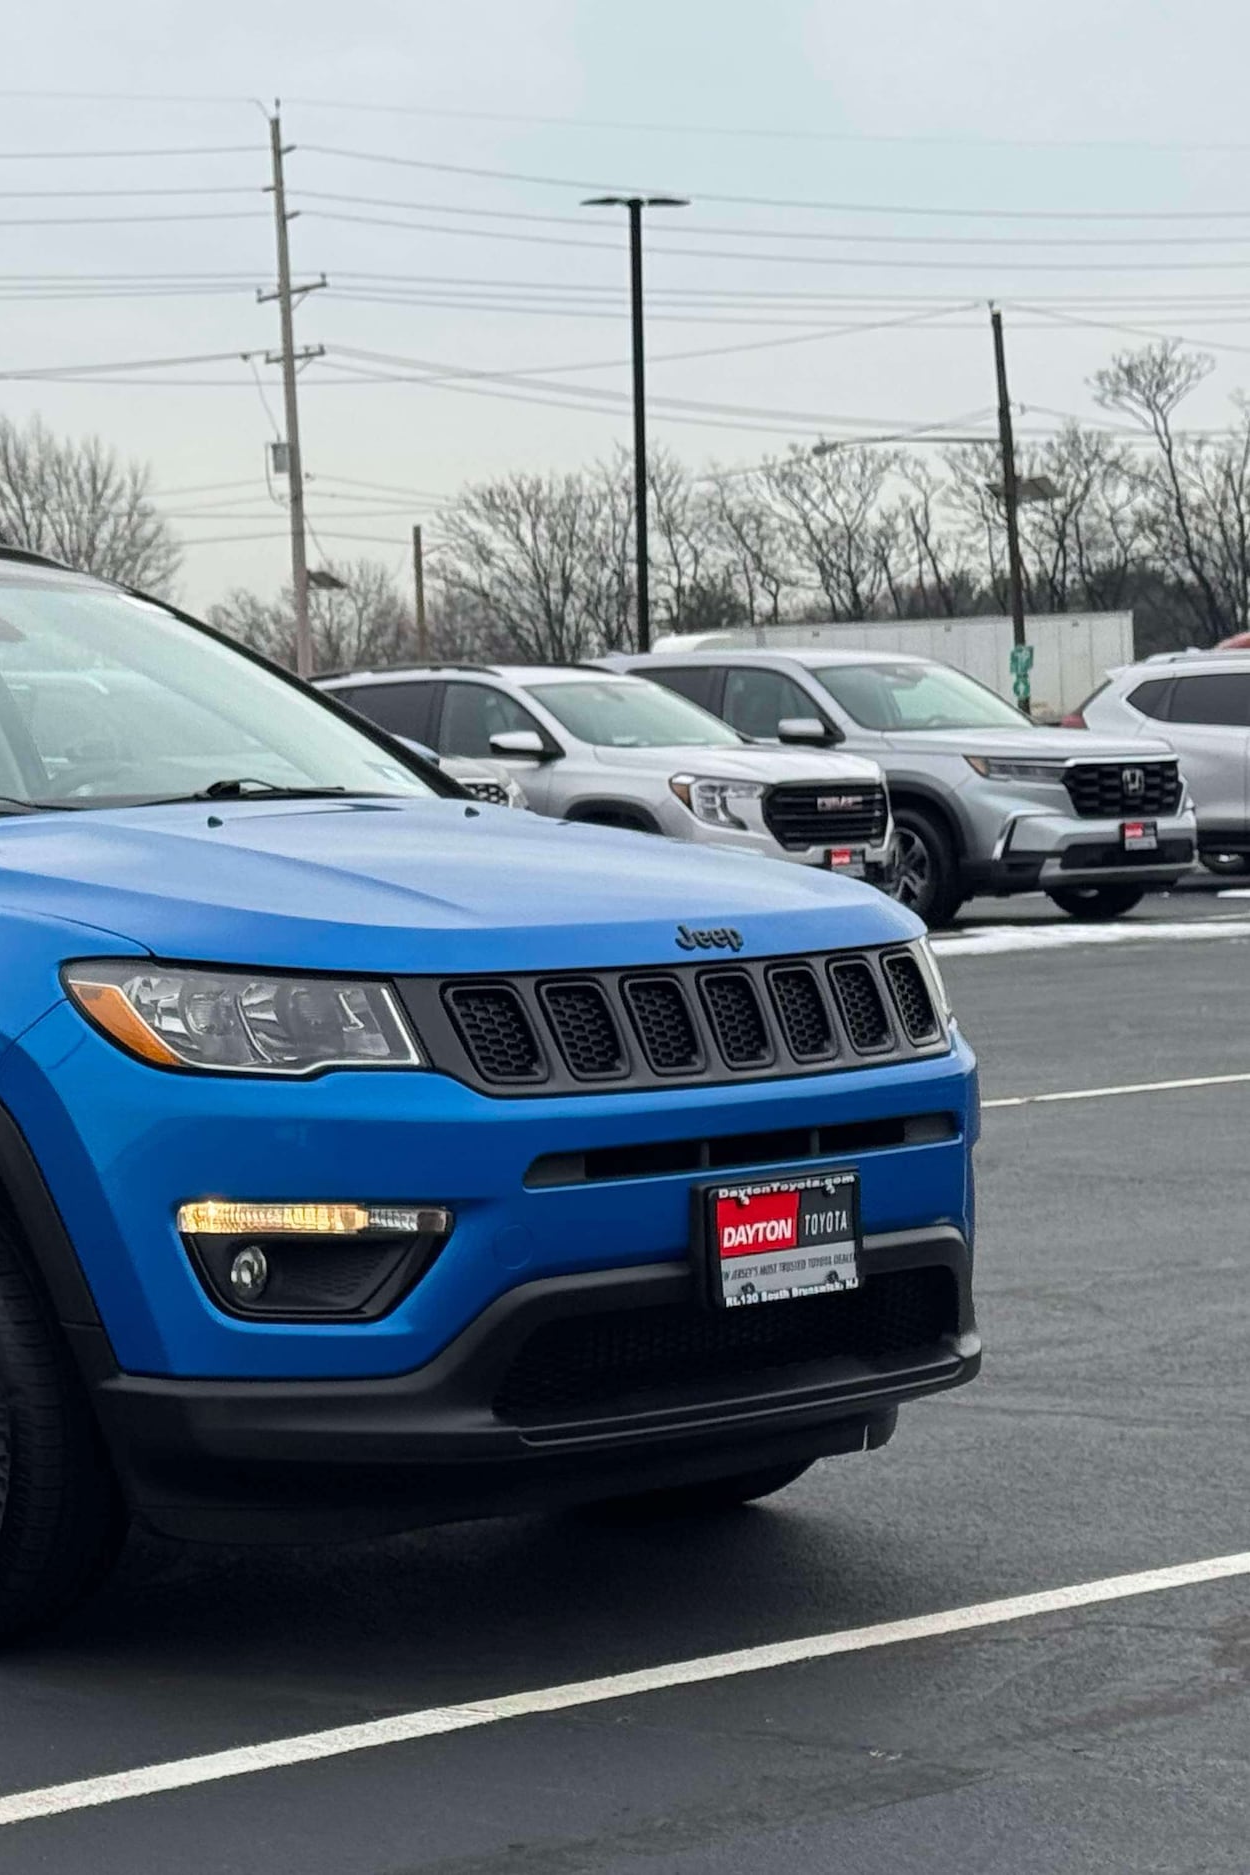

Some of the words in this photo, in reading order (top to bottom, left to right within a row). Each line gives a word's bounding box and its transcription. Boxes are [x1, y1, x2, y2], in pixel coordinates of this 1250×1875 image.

[675, 925, 744, 952] Jeep
[718, 1174, 855, 1200] DaytonToyota.com
[723, 1218, 792, 1248] DAYTON
[805, 1211, 847, 1235] TOYOTA
